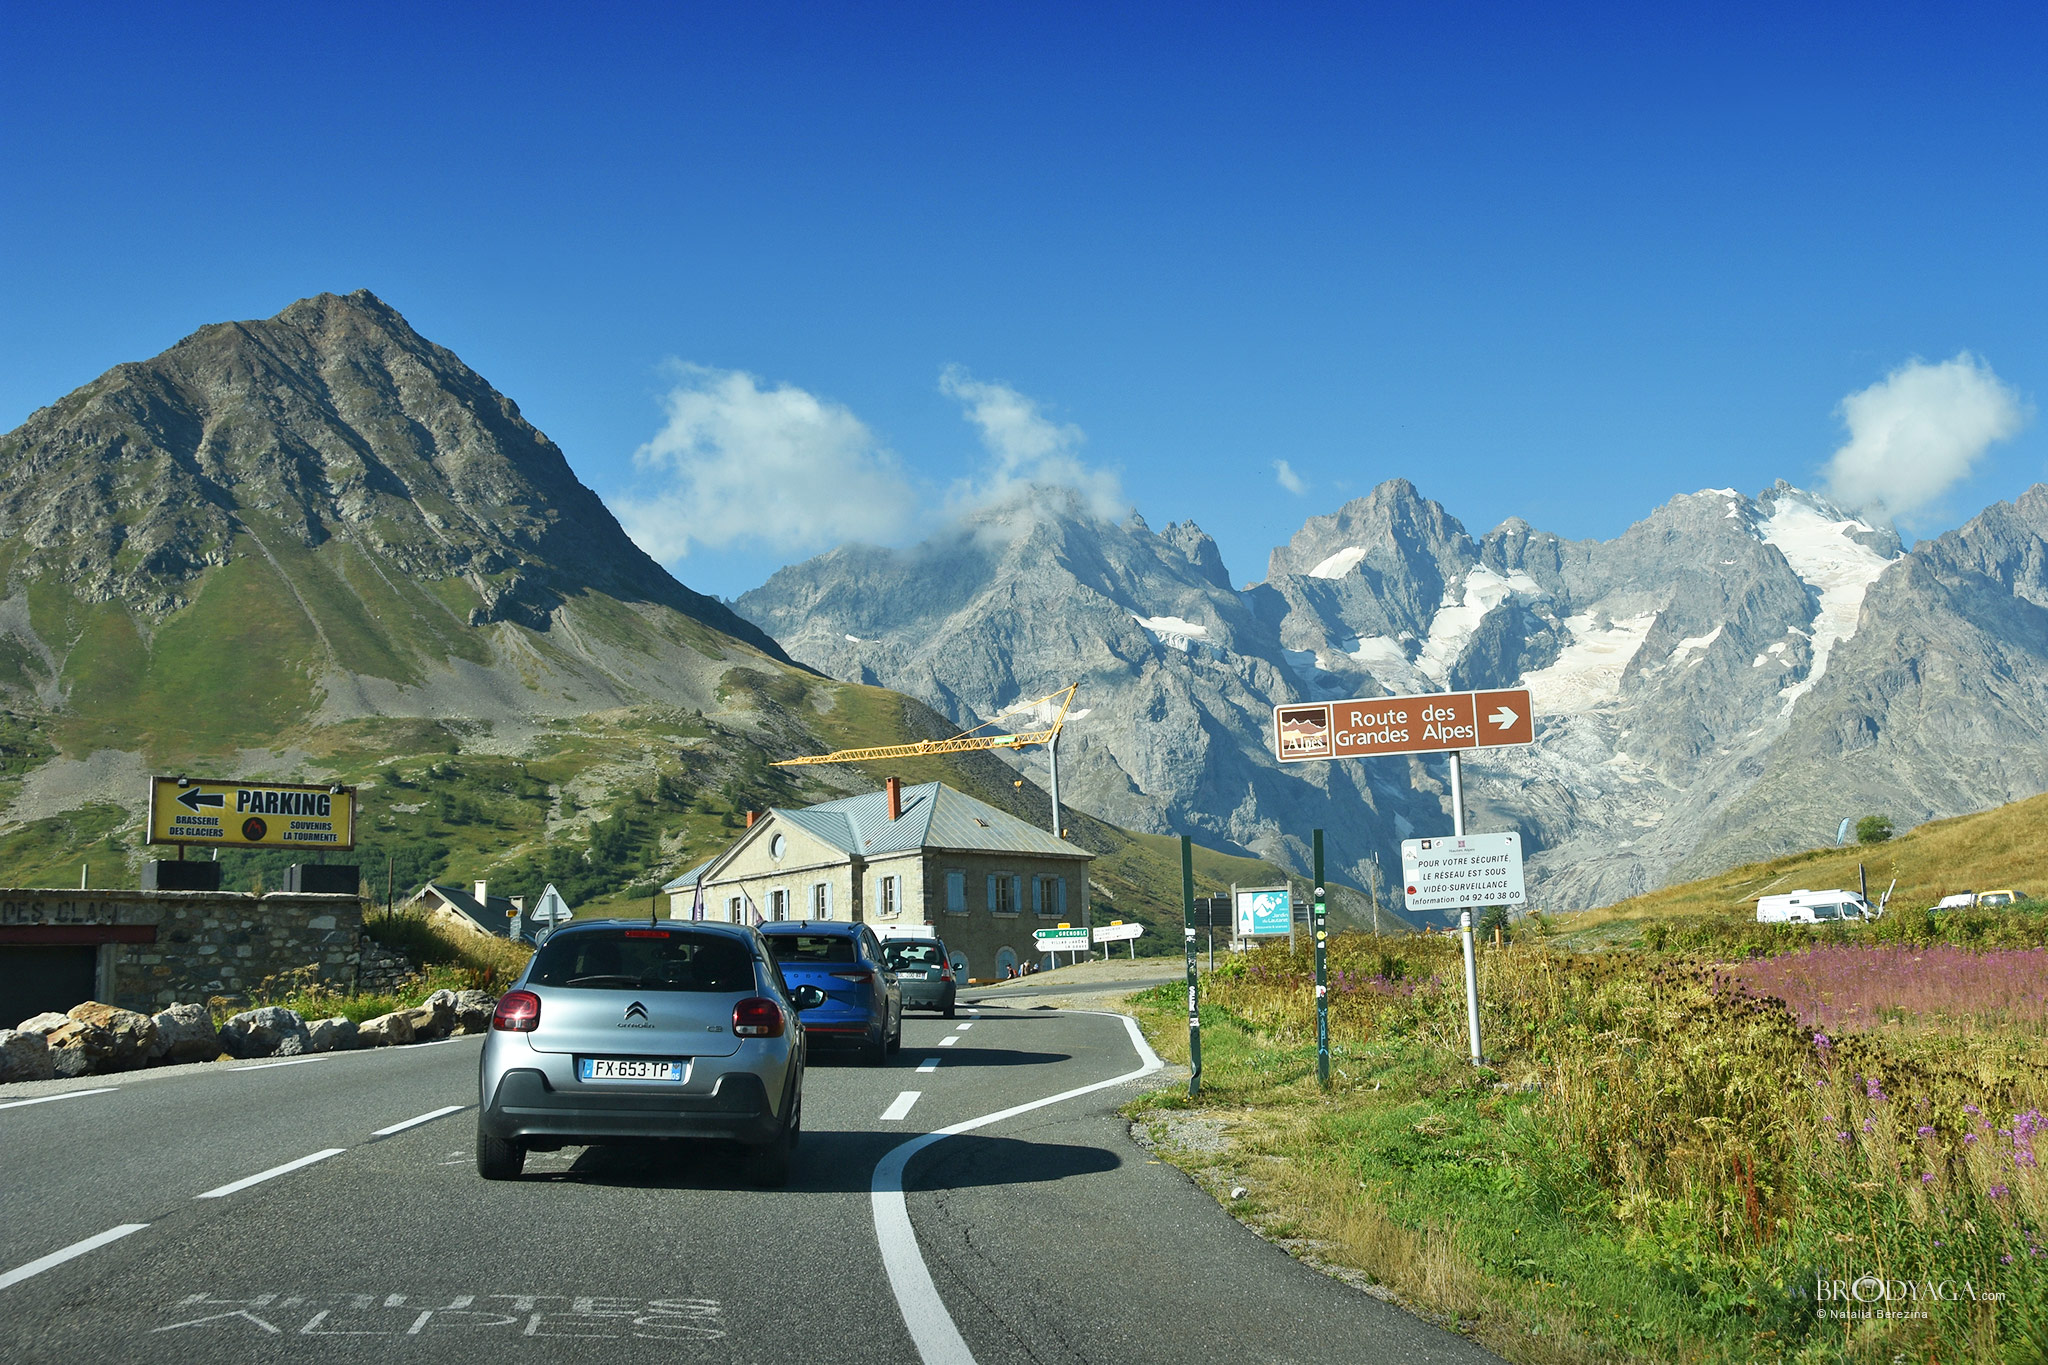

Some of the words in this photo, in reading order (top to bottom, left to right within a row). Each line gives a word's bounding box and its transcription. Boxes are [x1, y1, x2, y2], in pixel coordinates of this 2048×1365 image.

[1350, 709, 1408, 727] Route
[1421, 704, 1456, 722] des
[1335, 727, 1409, 747] Grandes
[1422, 722, 1474, 743] Alpes
[1288, 735, 1326, 752] Alpes
[237, 790, 331, 816] PARKING
[175, 815, 219, 826] BRASSERIE
[290, 820, 332, 831] SOUVENIRS
[169, 826, 186, 836] DES
[186, 827, 224, 838] GLACIERS
[283, 831, 293, 840] LA
[293, 832, 338, 842] TOURMENTE
[1418, 859, 1440, 868] POUR
[1442, 857, 1468, 866] VOTRE
[1434, 870, 1465, 880] RÉSEAU
[1468, 869, 1482, 877] EST
[1485, 867, 1506, 877] SOUS
[1412, 896, 1455, 905] Information
[1459, 894, 1470, 902] 04
[1472, 893, 1482, 901] 92
[1484, 892, 1495, 900] 40
[1509, 891, 1520, 899] 00
[595, 1061, 669, 1077] FX-653-TP
[148, 1309, 727, 1340] ALPES
